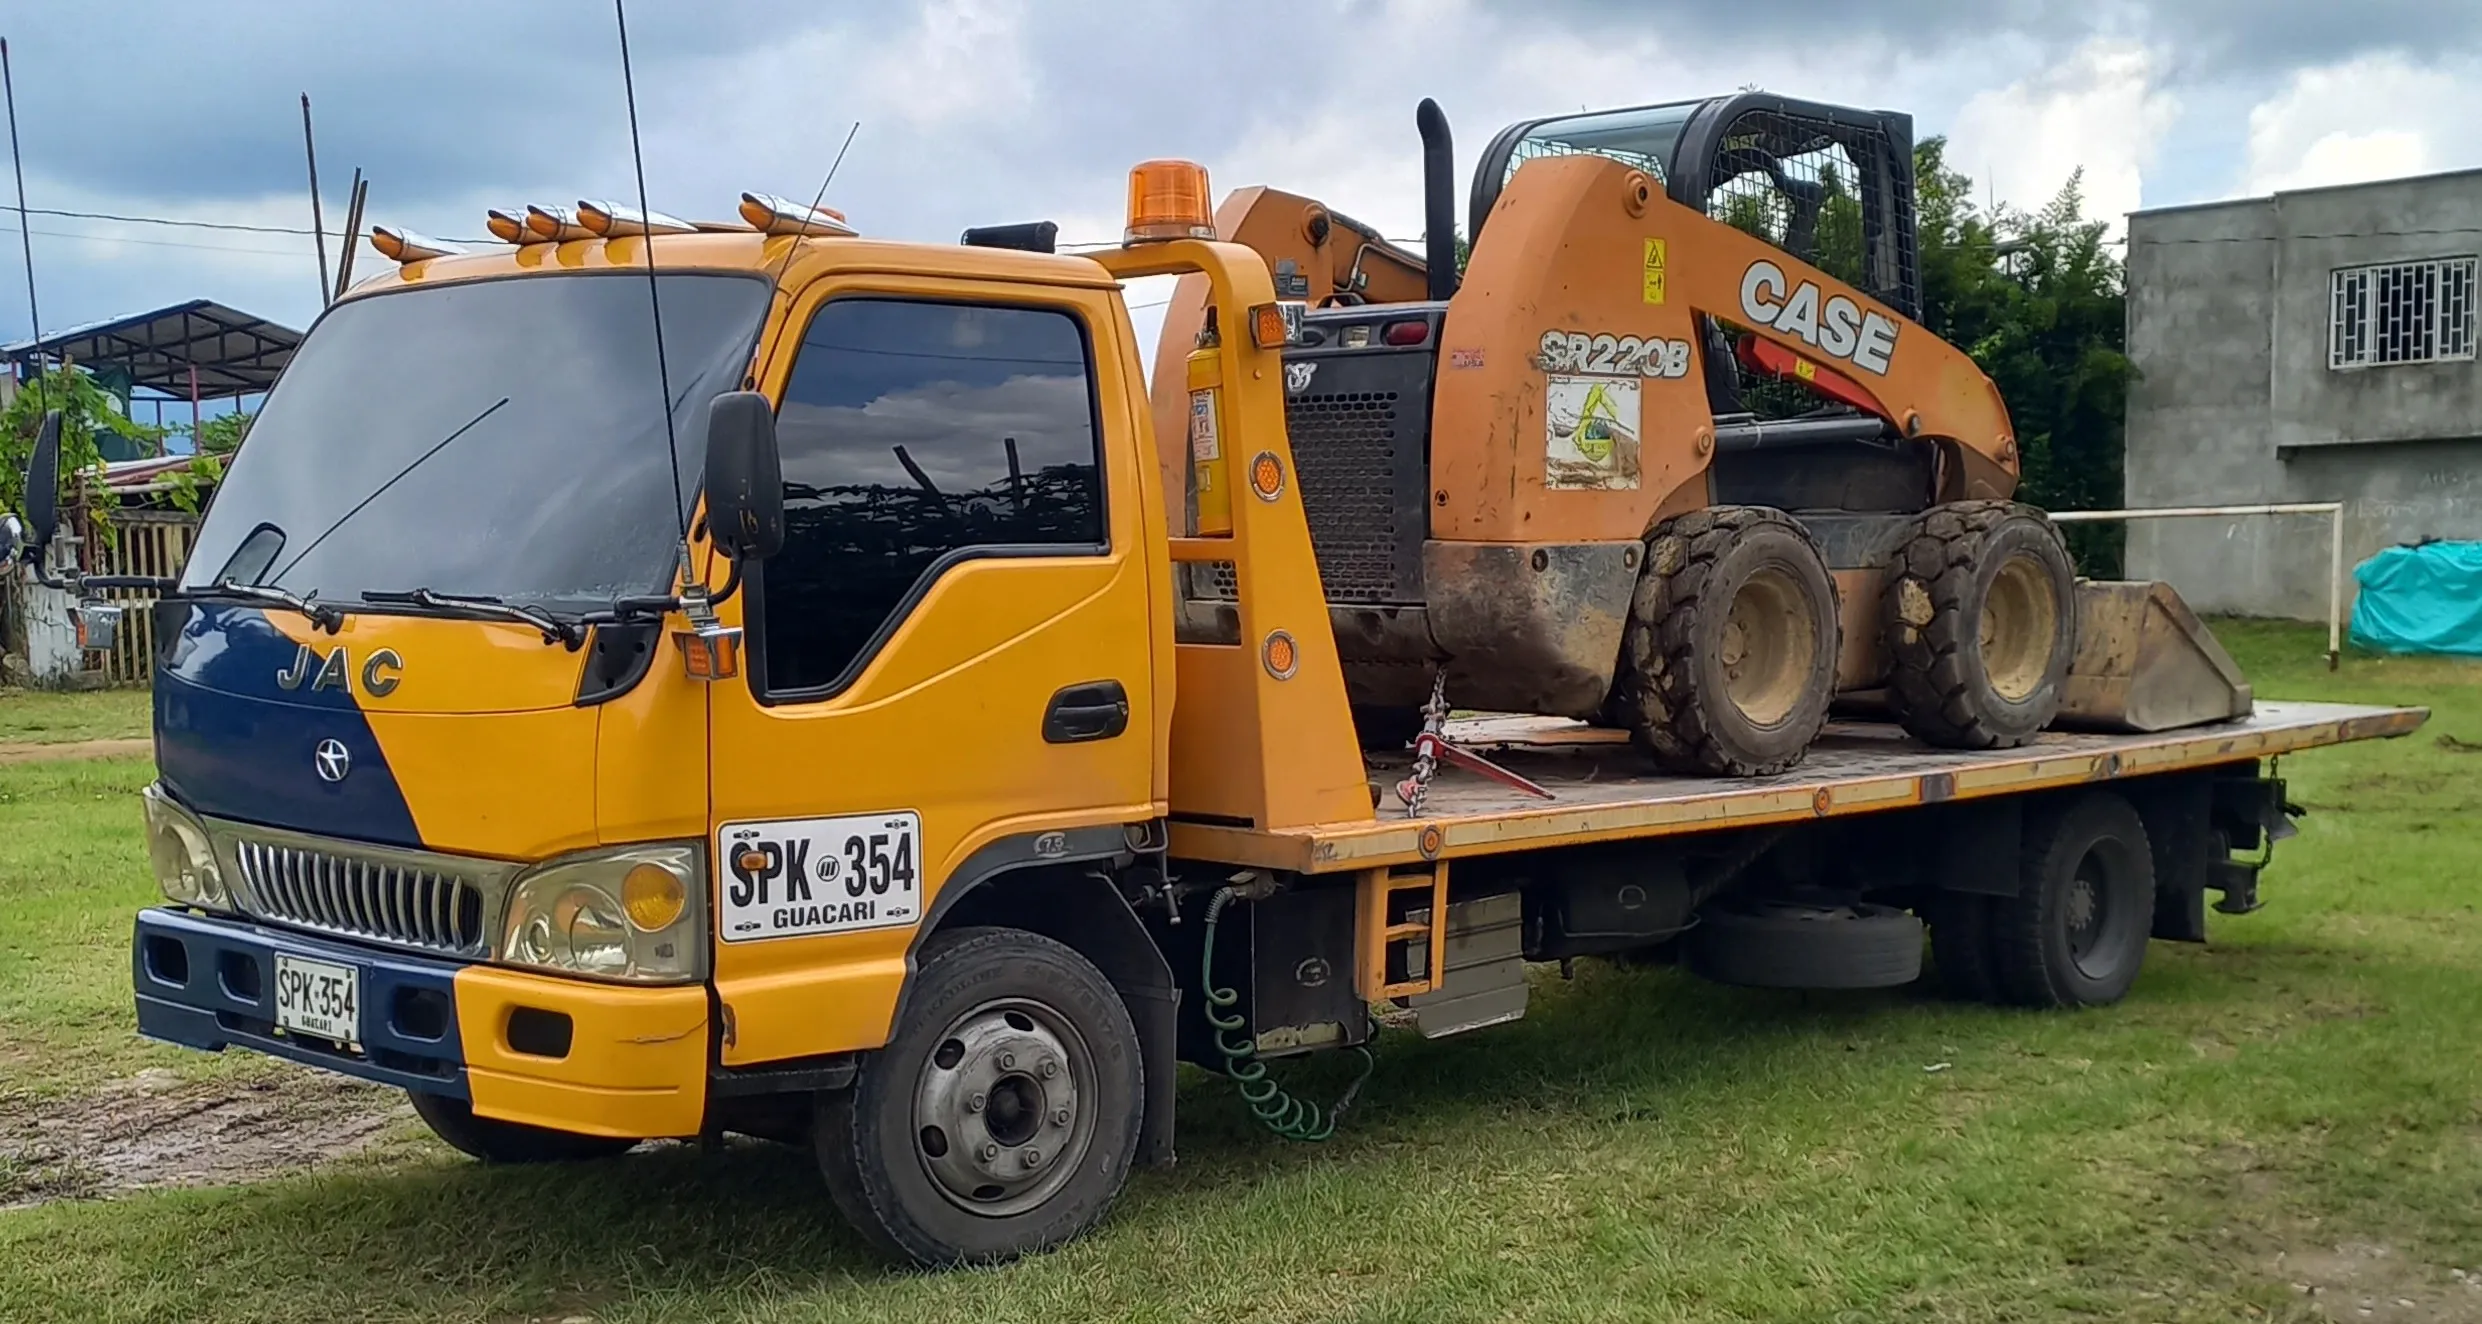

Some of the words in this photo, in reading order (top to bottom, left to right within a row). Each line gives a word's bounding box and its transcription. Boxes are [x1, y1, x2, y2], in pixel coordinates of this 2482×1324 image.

[1740, 259, 1901, 376] CASE
[1538, 329, 1690, 378] SR220B
[277, 642, 402, 697] JAC
[729, 838, 812, 908] SPK
[844, 832, 914, 897] 354
[773, 900, 875, 929] GUACARI
